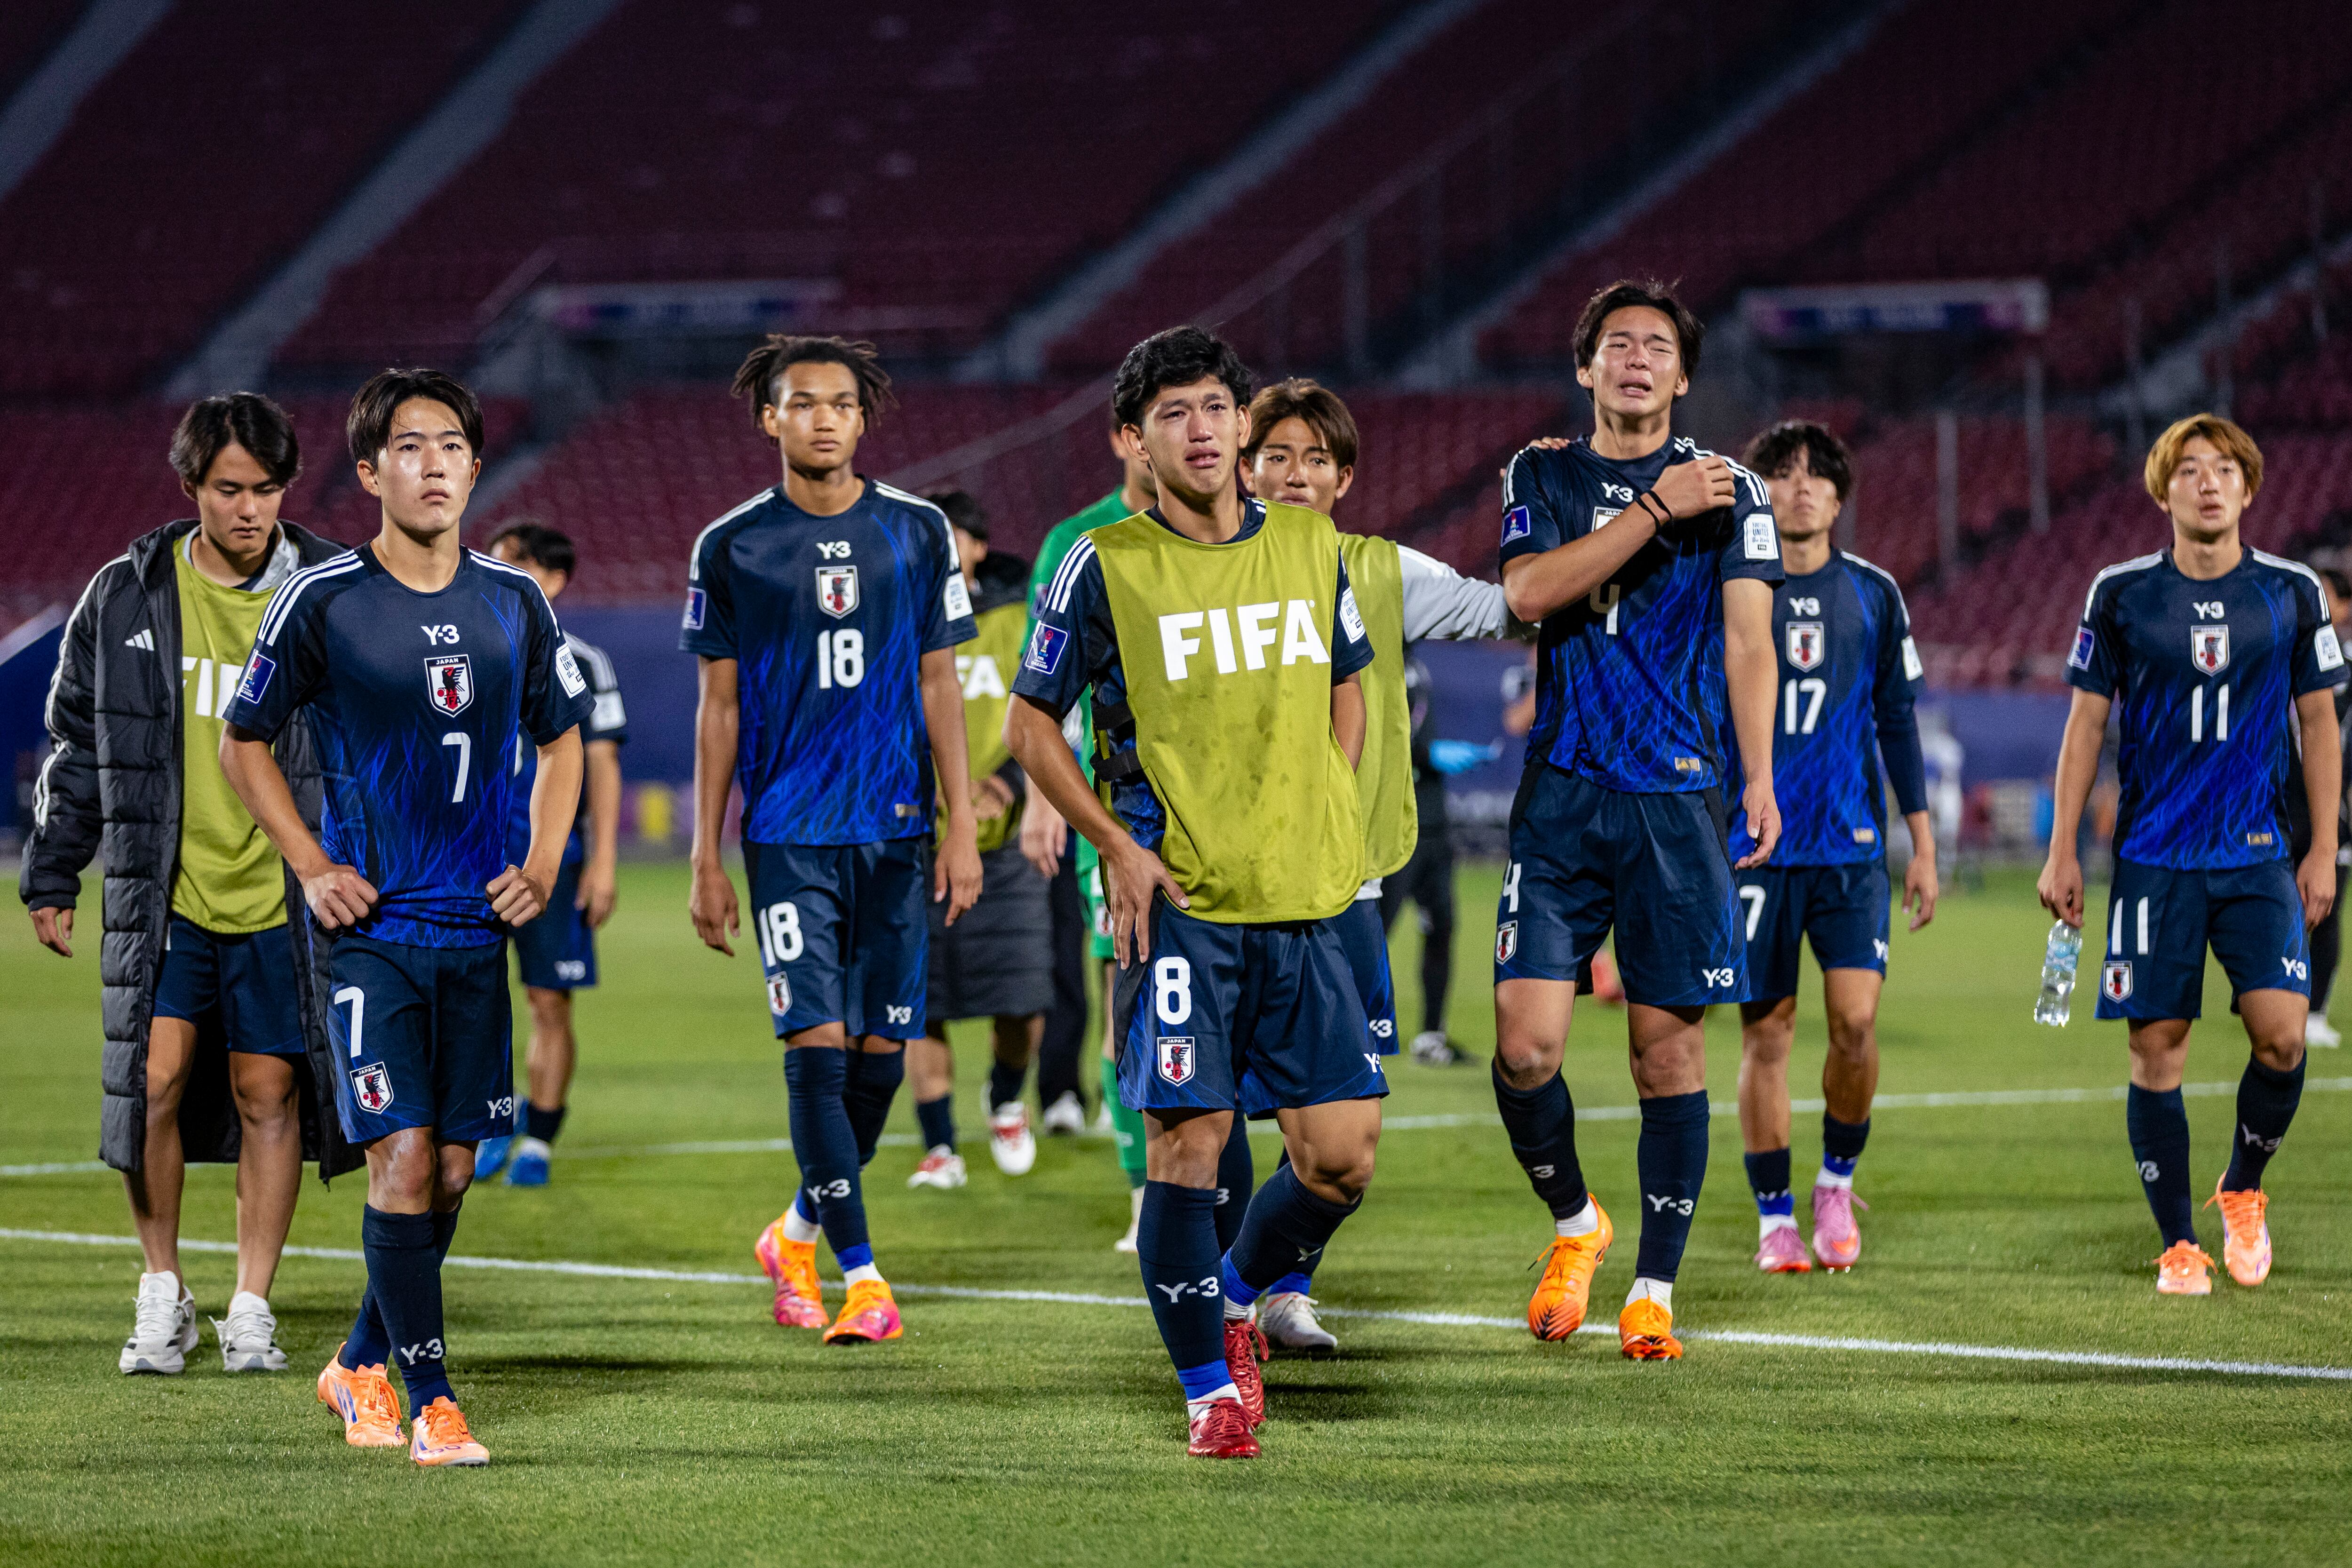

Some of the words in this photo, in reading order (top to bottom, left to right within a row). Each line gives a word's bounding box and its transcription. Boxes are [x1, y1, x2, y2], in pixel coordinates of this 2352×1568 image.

[1601, 482, 1634, 503] Y-3
[816, 541, 852, 560] Y-3
[421, 624, 460, 645] Y-3
[1158, 599, 1331, 681] FIFA
[436, 657, 459, 669] JAPAN
[817, 629, 864, 689] 18
[443, 696, 462, 706] JFA
[1785, 678, 1827, 734] 17
[2191, 684, 2229, 742] 11
[442, 732, 471, 803] 7
[1503, 858, 1522, 913] 4
[1739, 884, 1766, 942] 7
[2112, 896, 2148, 955] 11
[759, 901, 804, 967] 18
[1155, 956, 1192, 1025] 8
[1702, 967, 1734, 988] Y-3
[334, 986, 365, 1058] 7
[886, 1004, 913, 1025] Y-3
[358, 1066, 376, 1075] JAPAN
[487, 1097, 512, 1119] Y-3
[807, 1178, 851, 1203] Y-3
[1647, 1193, 1694, 1217] Y-3
[1155, 1276, 1219, 1303] Y-3
[401, 1338, 444, 1365] Y-3
